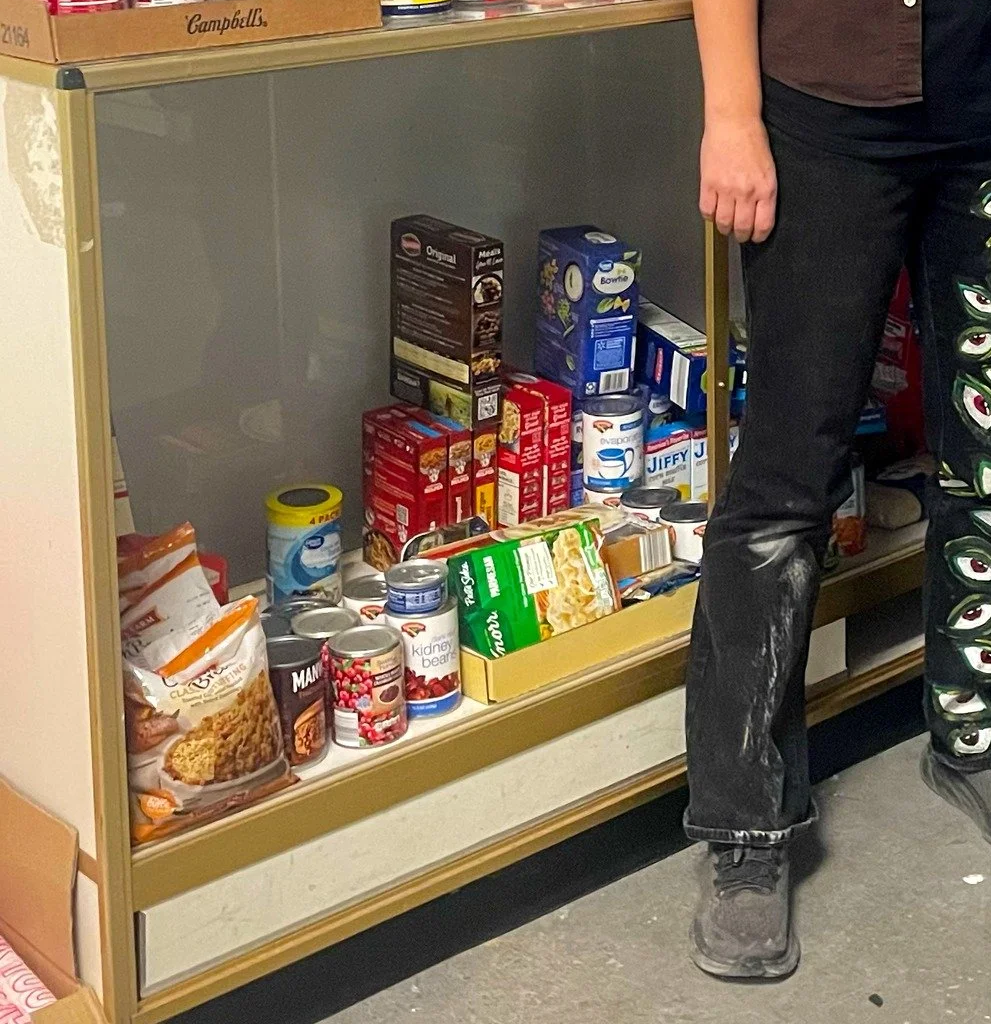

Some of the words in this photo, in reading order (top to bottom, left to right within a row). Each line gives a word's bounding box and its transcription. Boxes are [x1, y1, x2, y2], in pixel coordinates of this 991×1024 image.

[186, 7, 263, 35] Campbell's
[426, 245, 457, 265] Original
[647, 448, 688, 474] JIFFY
[309, 517, 316, 525] 4
[411, 640, 453, 658] kidney
